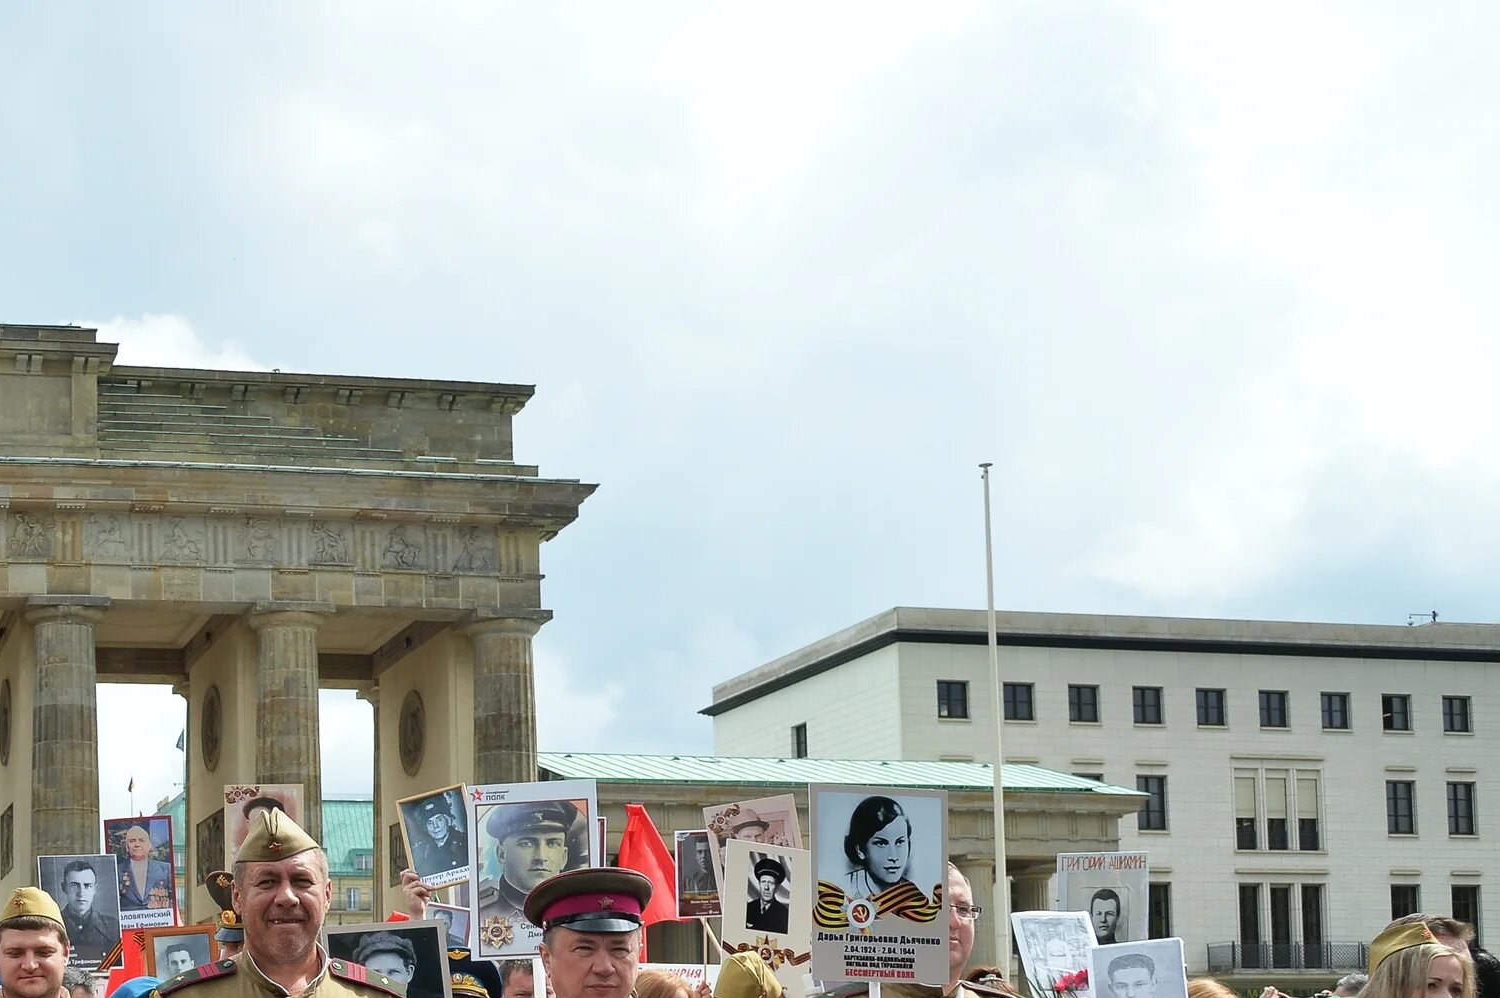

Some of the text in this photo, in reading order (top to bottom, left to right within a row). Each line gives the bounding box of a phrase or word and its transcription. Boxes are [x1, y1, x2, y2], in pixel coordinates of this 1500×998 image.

[1061, 854, 1106, 871] ГРИГОРИЙ
[817, 932, 941, 945] Дарья Григорьевна Дьяченко
[844, 945, 876, 954] 2.04.1924
[882, 947, 898, 955] 2.04.
[845, 969, 895, 978] БЕССМЕРТНЫЙ
